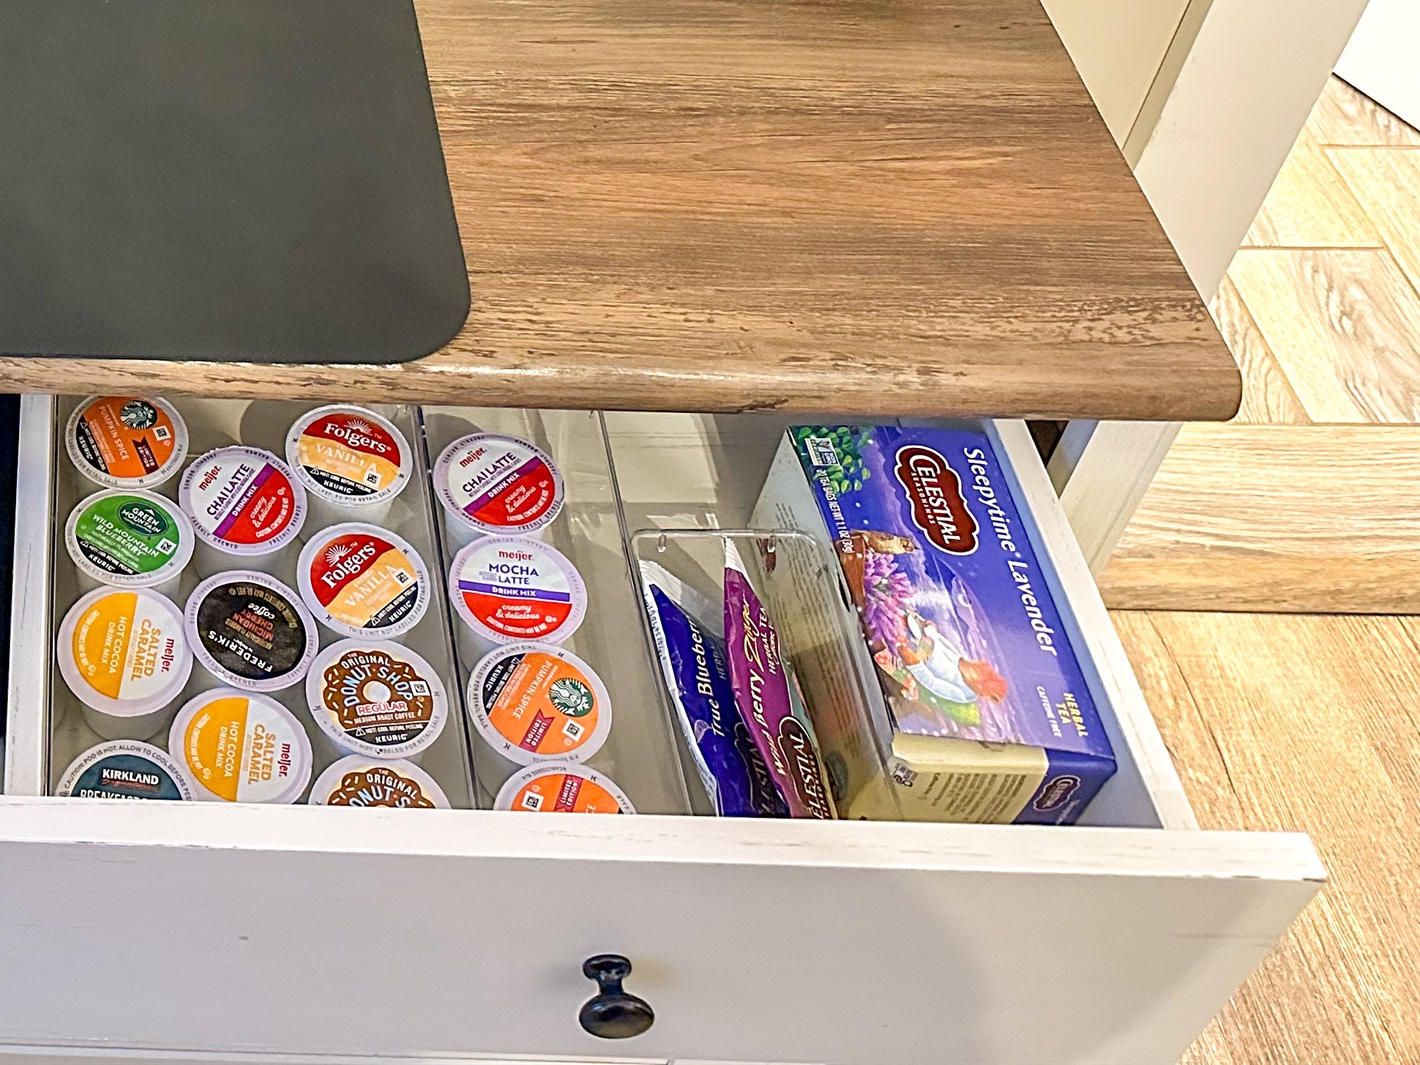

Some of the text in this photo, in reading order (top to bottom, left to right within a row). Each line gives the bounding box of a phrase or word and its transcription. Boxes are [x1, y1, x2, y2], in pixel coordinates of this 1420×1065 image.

[99, 405, 120, 438] PUMPKIN
[113, 436, 130, 461] SPICE
[323, 422, 387, 453] Folgers
[323, 480, 354, 494] KEURIG
[462, 452, 517, 493] CHAI LATTE
[488, 472, 521, 498] DRINK MIX
[206, 489, 229, 516] CHAI
[226, 463, 251, 493] LATTE
[231, 484, 259, 516] DRINK MIX
[823, 486, 837, 501] BAGS
[909, 454, 961, 544] CELESTIAL
[911, 472, 936, 524] SEASONINGS
[121, 510, 161, 533] MOUNTAIN
[132, 507, 160, 526] GREEN
[93, 514, 114, 530] WILD
[113, 527, 160, 558] MOUNTAIN
[96, 524, 143, 556] BLUEBERRY
[964, 447, 1058, 657] Sleepytime Lavender
[88, 554, 116, 572] KEURIG
[321, 543, 376, 589] Folgers
[489, 563, 539, 577] MOCHA
[344, 564, 398, 607] VANILLA
[491, 586, 536, 597] DRINK MIX
[498, 575, 530, 585] LATTE
[232, 612, 275, 641] MICHIGAN
[241, 608, 274, 630] CHERRY
[247, 602, 275, 620] coffee
[388, 600, 412, 623] KEURIG
[101, 621, 116, 664] DRINK MIX
[108, 616, 128, 674] HOT COCOA
[131, 618, 151, 681] CARAMEL
[143, 627, 161, 677] SALTED
[208, 630, 273, 673] FREDERIK'S
[686, 615, 714, 696] Blueberr
[341, 655, 391, 669] ORIGINAL
[341, 664, 414, 707] DONUT SHOP
[485, 665, 504, 692] KEURIG
[512, 660, 552, 720] PUMPKIN SPICE
[358, 702, 407, 714] REGULAR
[749, 668, 769, 729] Berry
[1036, 686, 1063, 738] CAFFEINE FREE
[1056, 702, 1072, 724] TEA
[1063, 692, 1089, 737] HERBAL
[525, 719, 542, 743] EDITION
[531, 721, 548, 747] LIMITED
[710, 699, 726, 737] True
[215, 726, 228, 768] DRINK MIX
[223, 720, 240, 778] HOT COCOA
[248, 723, 265, 785] CARAMEL
[375, 734, 408, 743] KEURIG
[762, 729, 786, 776] Wild
[151, 752, 168, 766] COOL
[260, 732, 276, 781] SALTED
[102, 768, 159, 785] KIRKLAND
[366, 773, 418, 799] ORIGINAL
[561, 779, 573, 804] LIMITED
[790, 732, 824, 819] ELESTIAL
[80, 789, 139, 800] BREAKF
[349, 785, 394, 807] ONUT
[567, 782, 579, 806] EDITION
